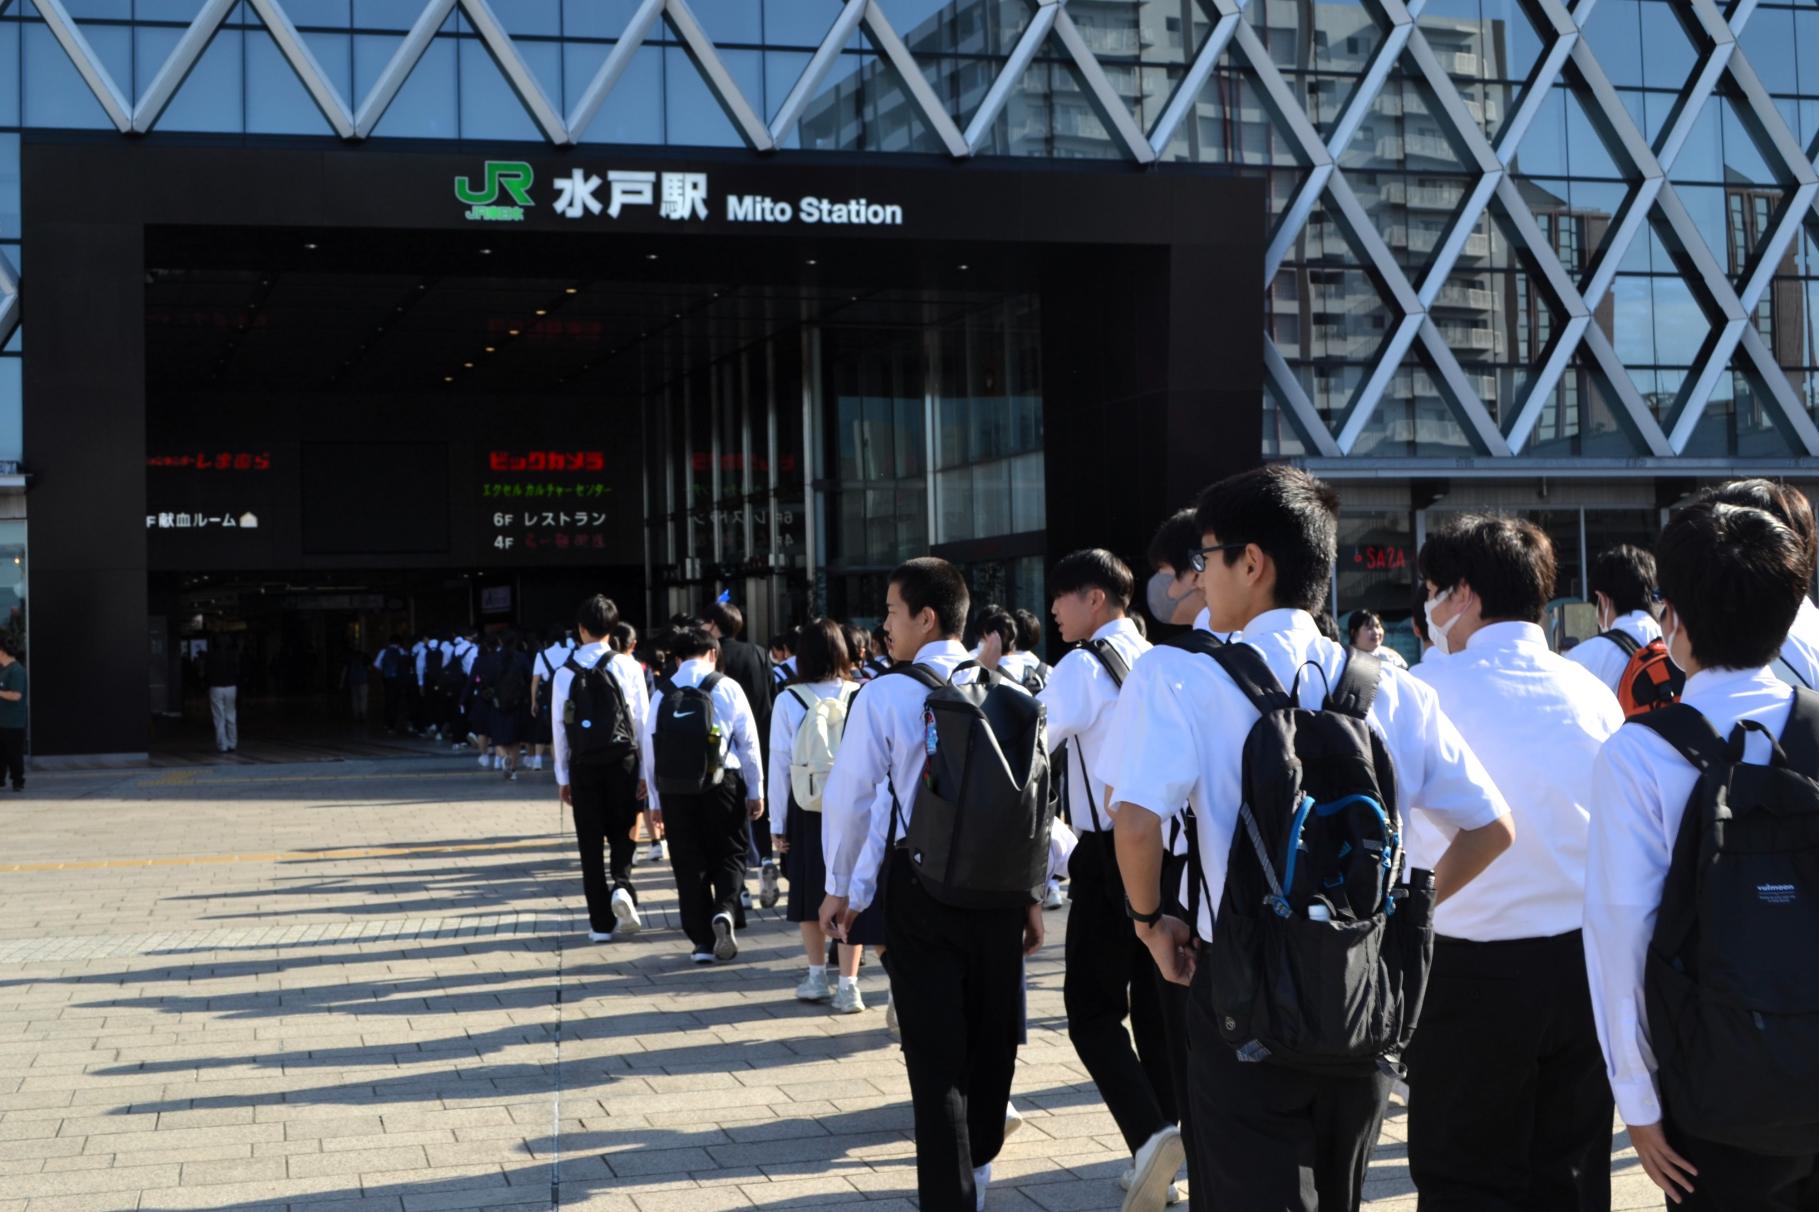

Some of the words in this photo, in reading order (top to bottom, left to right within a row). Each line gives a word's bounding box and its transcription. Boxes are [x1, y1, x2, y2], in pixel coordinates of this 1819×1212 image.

[455, 161, 536, 206] JR
[553, 168, 708, 220] 水戸駅
[727, 194, 792, 222] Mito
[799, 196, 903, 224] Station
[493, 512, 514, 527] 6F
[524, 511, 606, 527] レストラン
[494, 535, 515, 550] 4F
